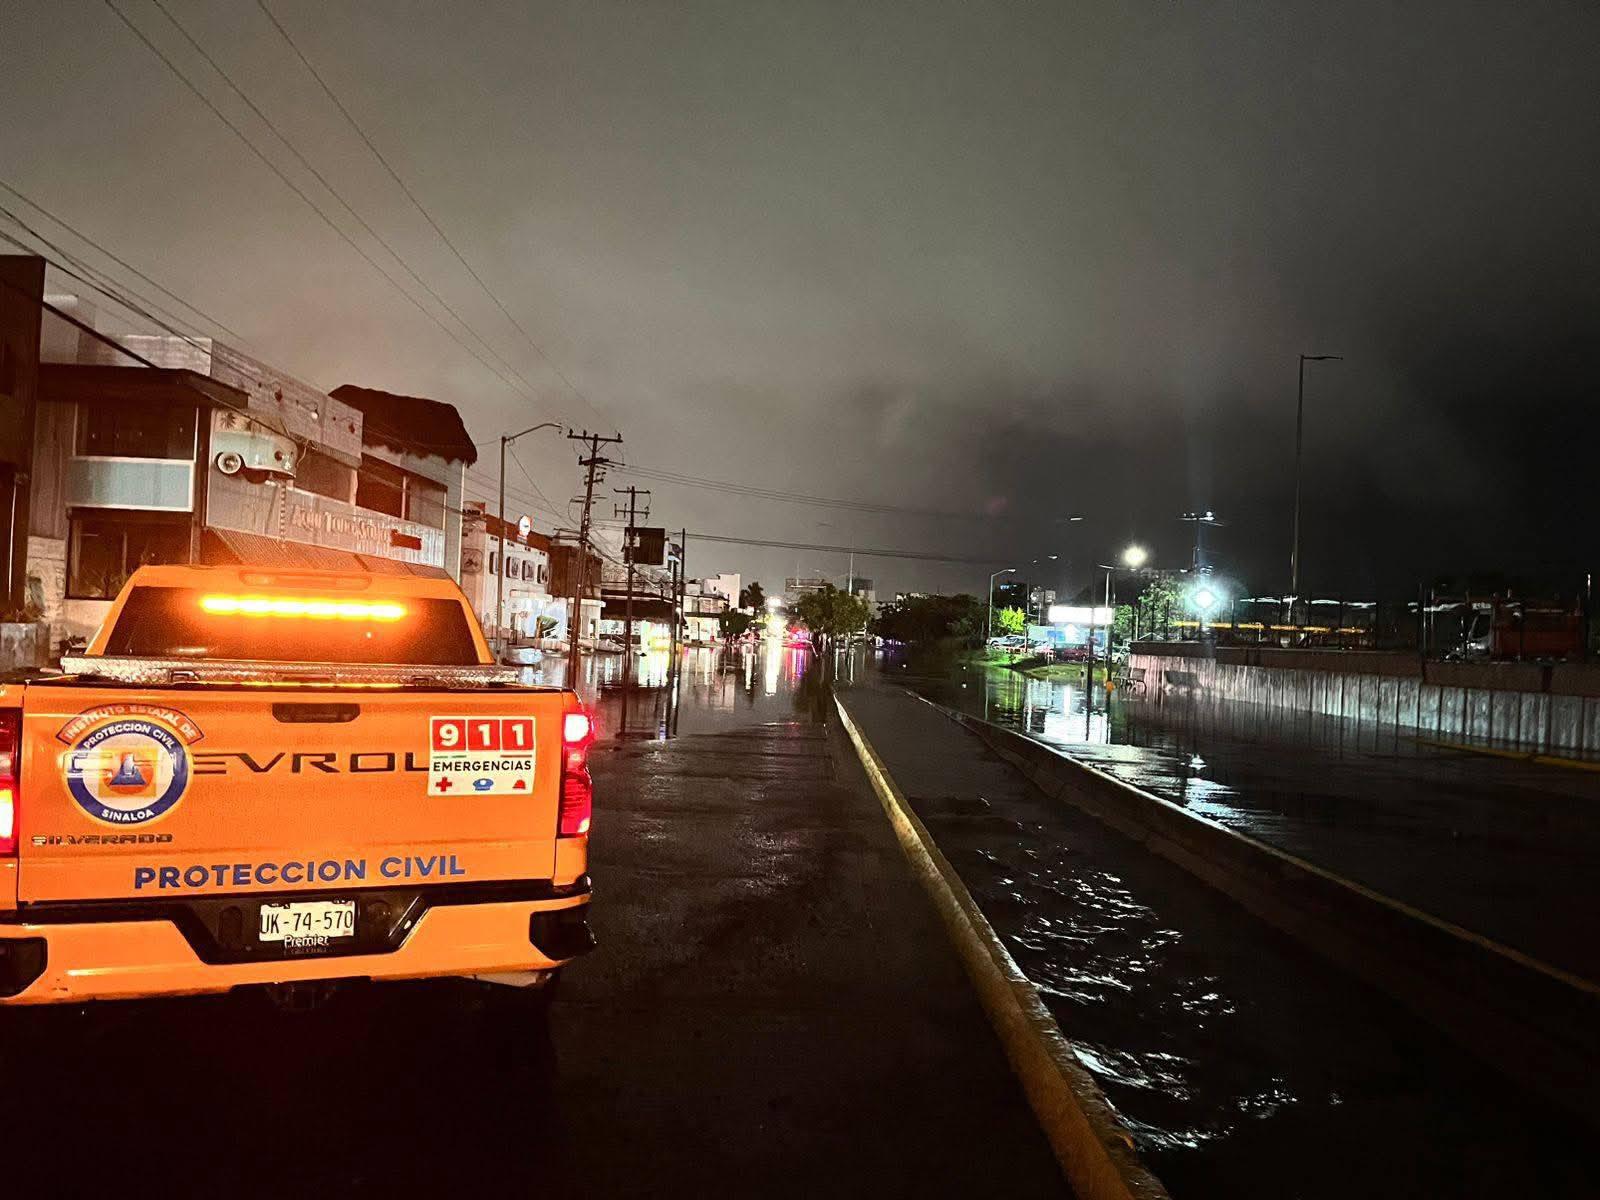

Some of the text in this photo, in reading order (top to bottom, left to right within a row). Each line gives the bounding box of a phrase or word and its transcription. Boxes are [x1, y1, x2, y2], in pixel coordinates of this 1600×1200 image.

[83, 722, 176, 750] PROTECCION CIVIL
[433, 760, 532, 772] EMERGENCIAS
[101, 808, 155, 822] SINALOA
[31, 833, 173, 846] SILVERADO
[134, 855, 466, 889] PROTECCION CIVIL
[284, 934, 330, 949] Premier
